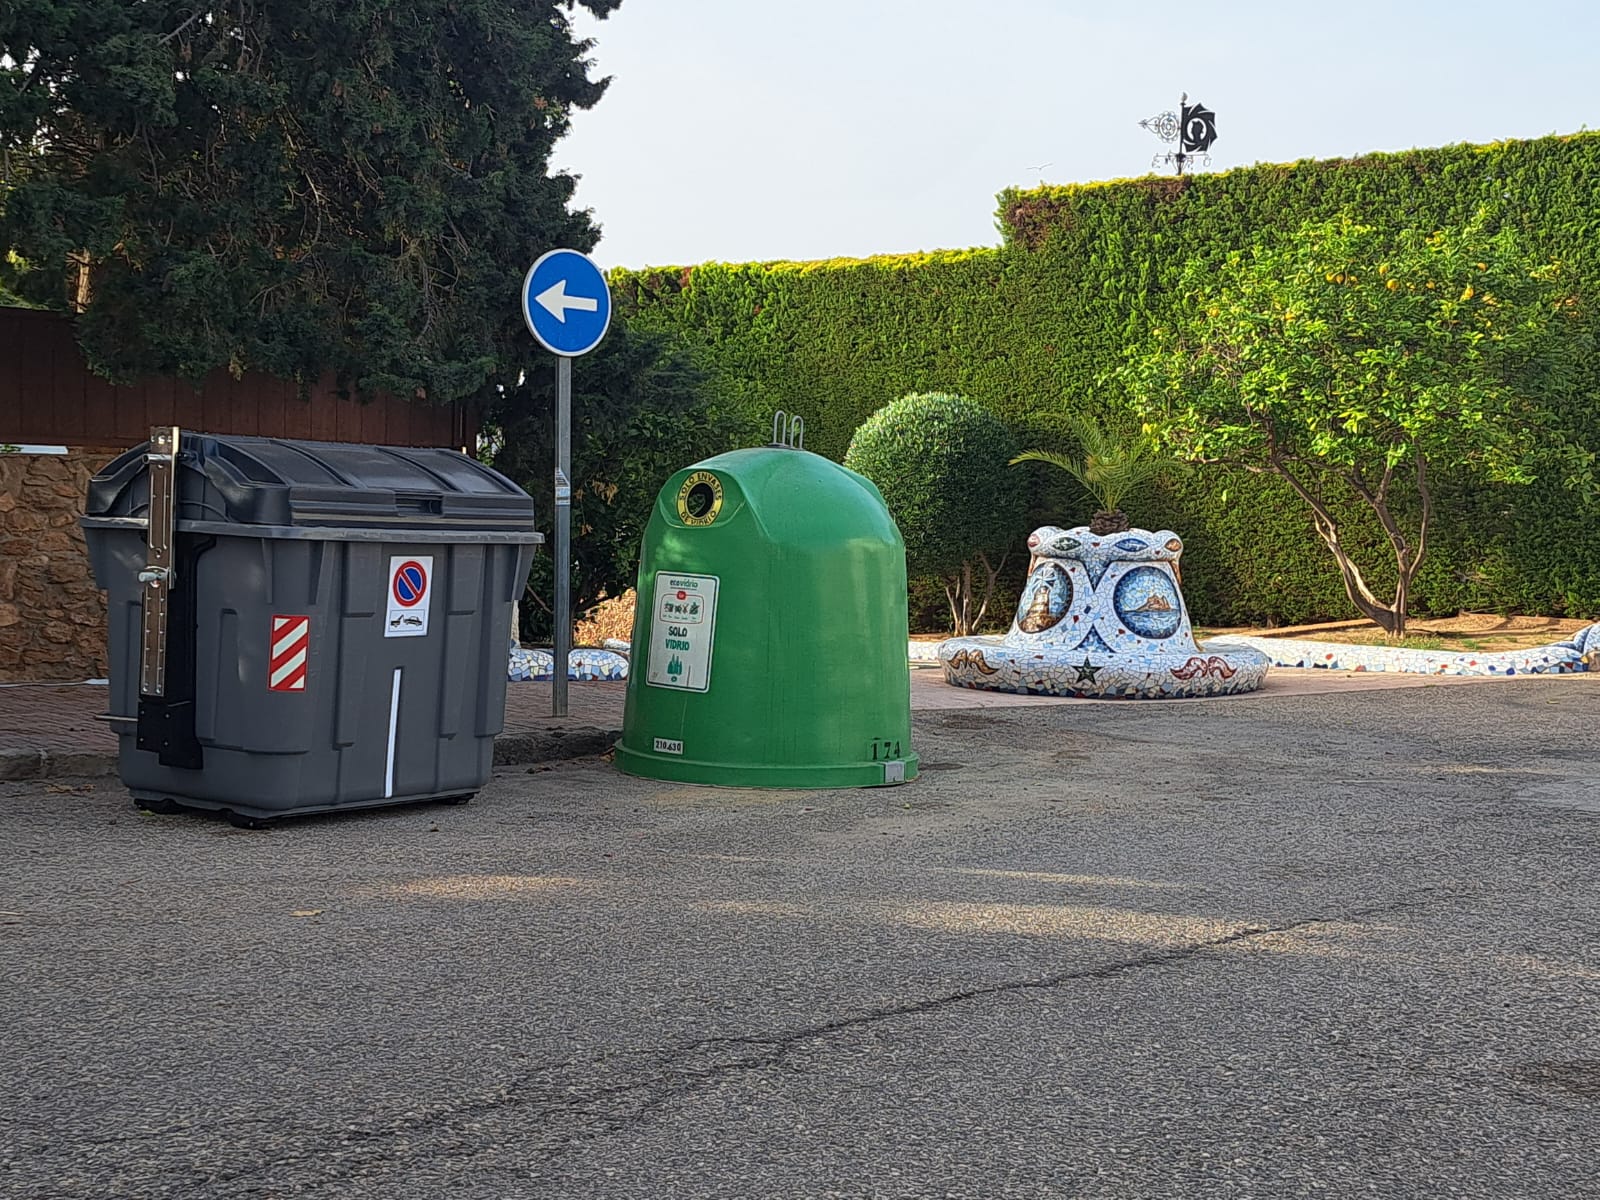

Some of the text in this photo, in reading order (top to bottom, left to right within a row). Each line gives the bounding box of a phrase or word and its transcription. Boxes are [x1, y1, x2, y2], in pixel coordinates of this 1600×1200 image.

[679, 472, 722, 500] SOLO ENVASES
[670, 579, 698, 589] ecovidrio
[668, 626, 688, 637] SOLO
[665, 638, 690, 651] VIDRIO
